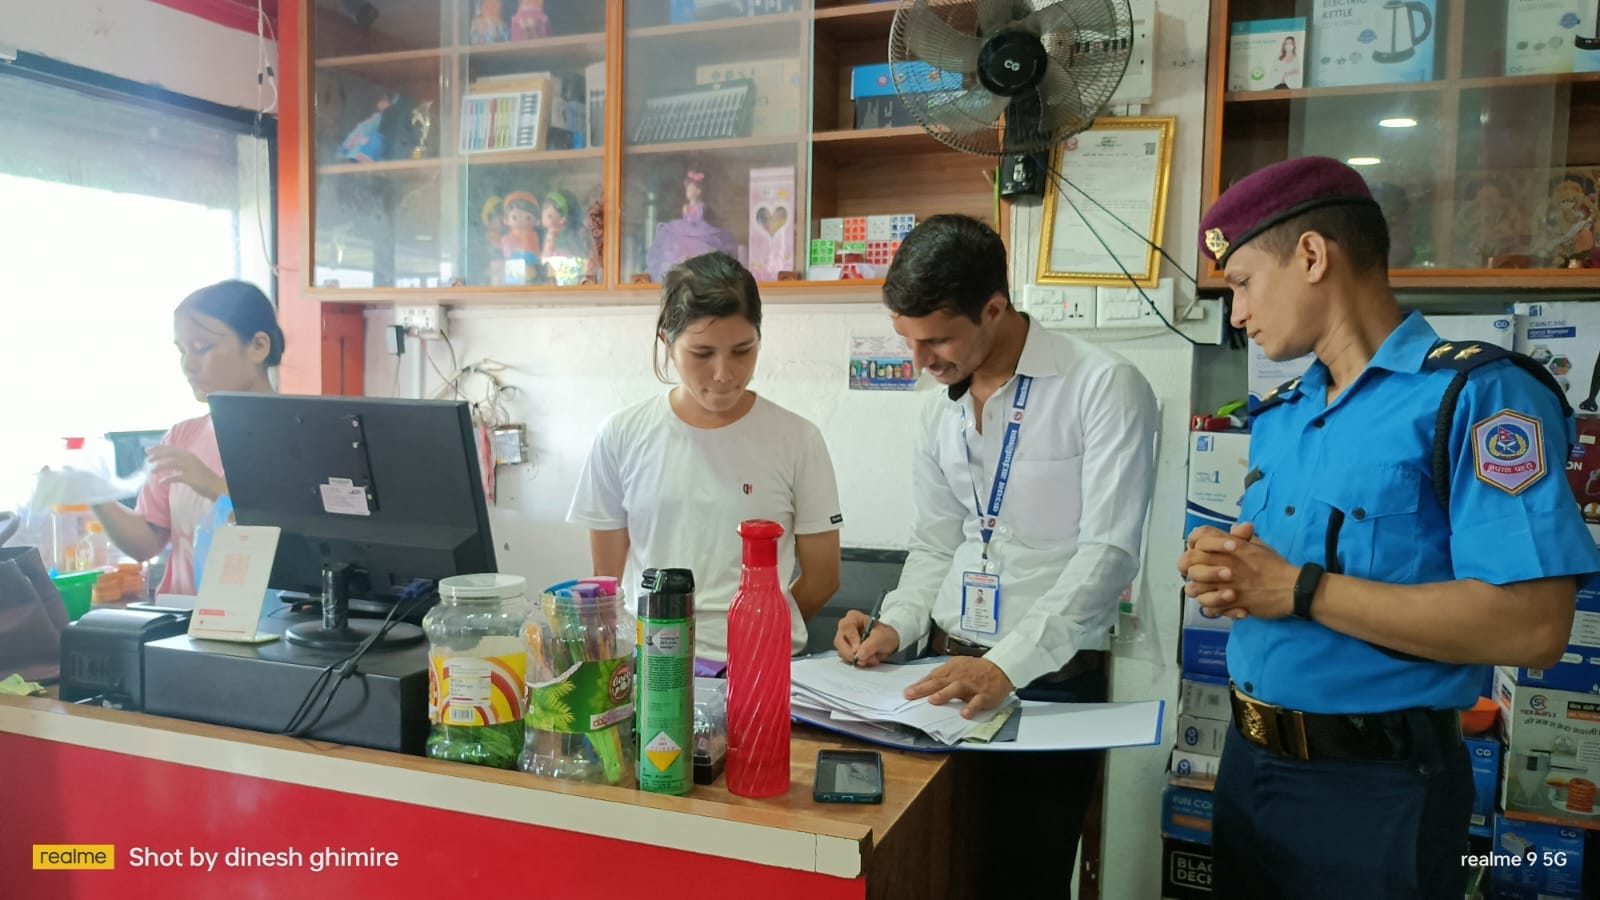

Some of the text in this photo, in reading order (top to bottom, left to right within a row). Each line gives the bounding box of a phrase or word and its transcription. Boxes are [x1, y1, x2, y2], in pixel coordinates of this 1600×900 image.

[1322, 8, 1353, 18] KETTLE
[1004, 59, 1020, 71] CG
[1476, 748, 1492, 757] CG
